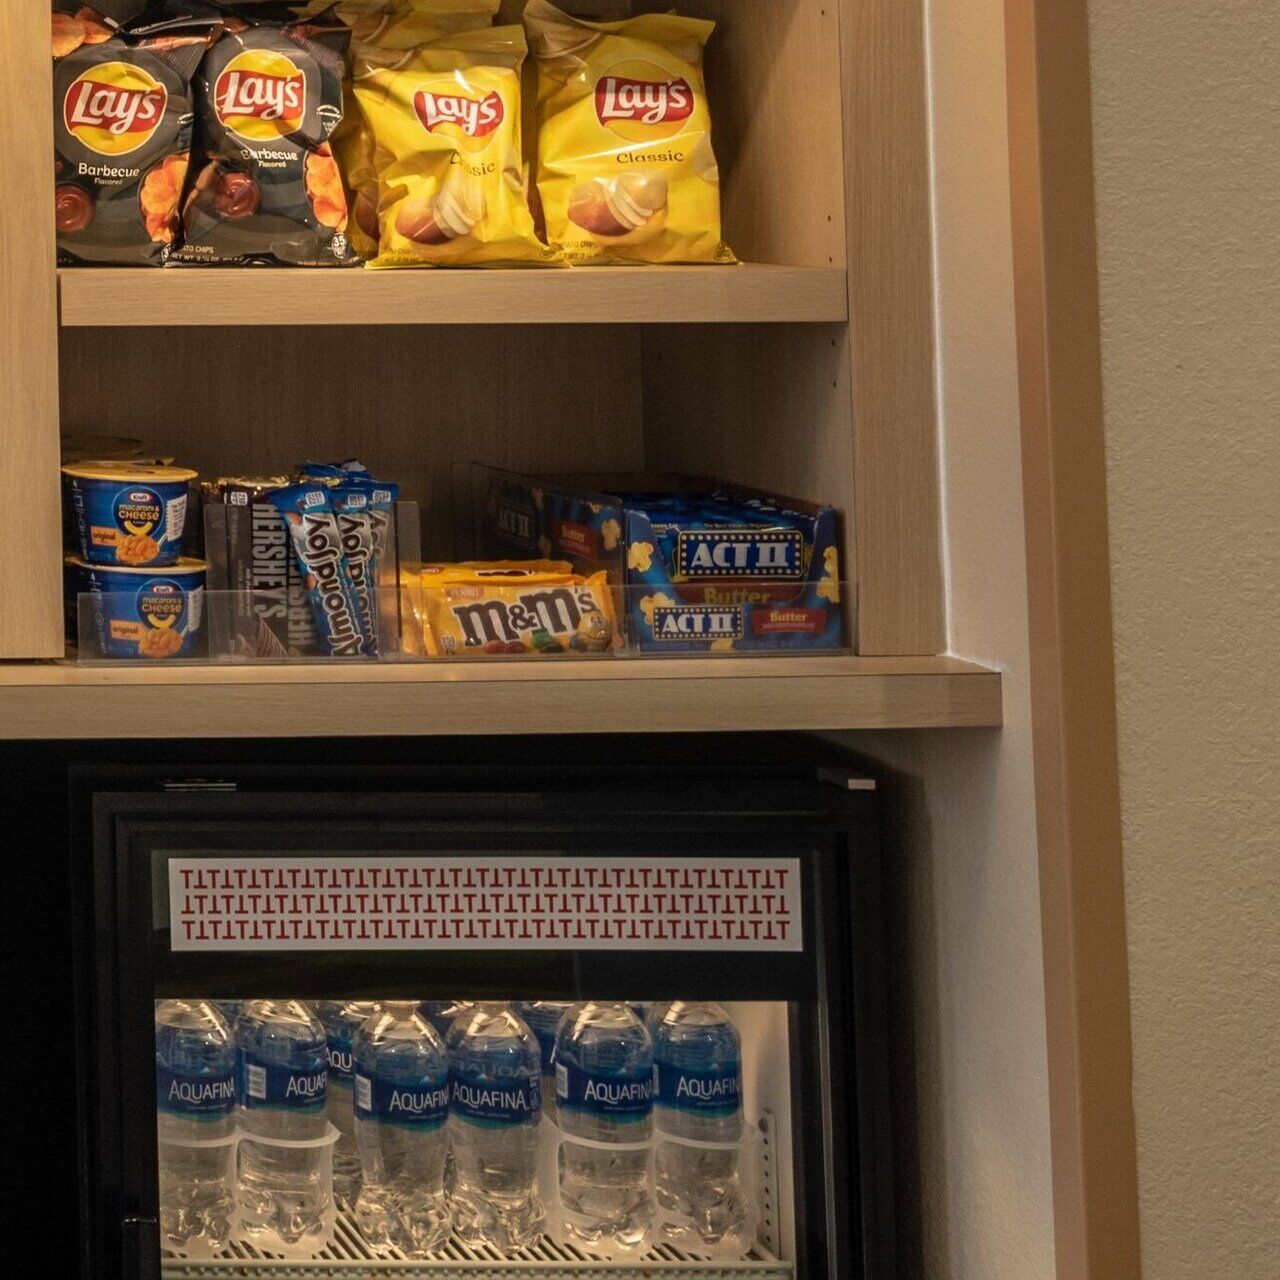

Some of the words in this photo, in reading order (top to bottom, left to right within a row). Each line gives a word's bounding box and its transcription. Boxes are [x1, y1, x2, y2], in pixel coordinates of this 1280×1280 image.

[70, 81, 162, 135] Lay's
[222, 71, 301, 120] Lay's
[601, 77, 687, 125] Lay's
[426, 91, 499, 137] Lay's
[240, 149, 299, 162] Barbecue
[616, 150, 685, 165] Classic
[78, 162, 140, 178] Barbecue
[252, 504, 288, 619] HERSHEY'S
[691, 542, 751, 568] ACT
[755, 542, 789, 567] II
[703, 587, 772, 604] Butter
[662, 613, 709, 633] ACT
[709, 613, 734, 632] II
[770, 610, 807, 622] Butter
[168, 1078, 236, 1104] AQUAFINA
[389, 1084, 450, 1114] AQUAFIN
[451, 1080, 530, 1111] AQUAFINA
